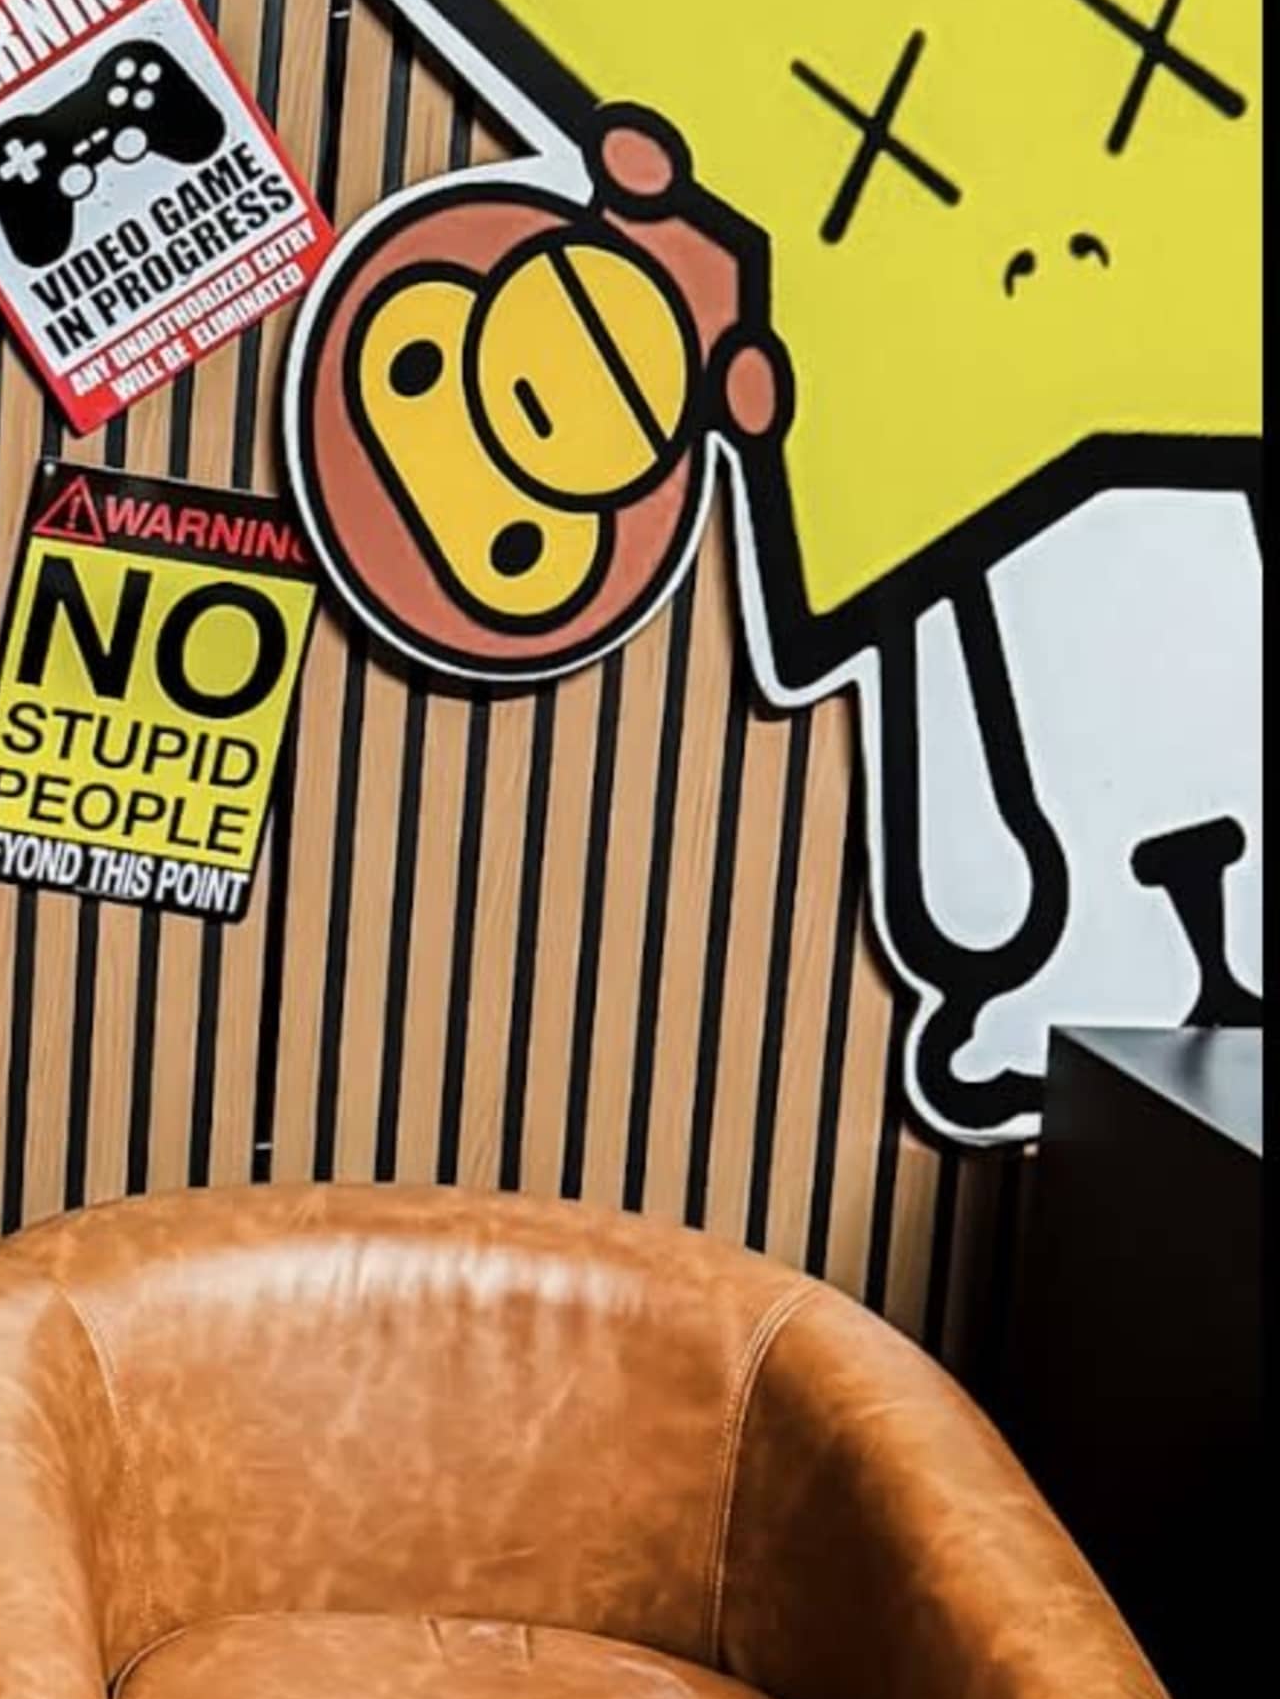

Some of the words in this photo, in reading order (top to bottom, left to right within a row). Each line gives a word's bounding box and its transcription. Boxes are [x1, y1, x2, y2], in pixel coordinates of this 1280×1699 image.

[30, 219, 151, 313] VIDEO
[149, 141, 263, 237] GAME
[45, 305, 97, 358] IN
[90, 174, 294, 327] PROGRESS
[69, 353, 112, 396] ANY
[107, 258, 257, 368] UNAUTHORIZED
[251, 218, 317, 275] ENTRY
[110, 358, 164, 402] WILL
[159, 337, 190, 370] BE
[16, 553, 288, 720] NO
[1, 702, 260, 789] STUPID
[86, 849, 153, 900] THIS
[154, 861, 250, 914] POINT
